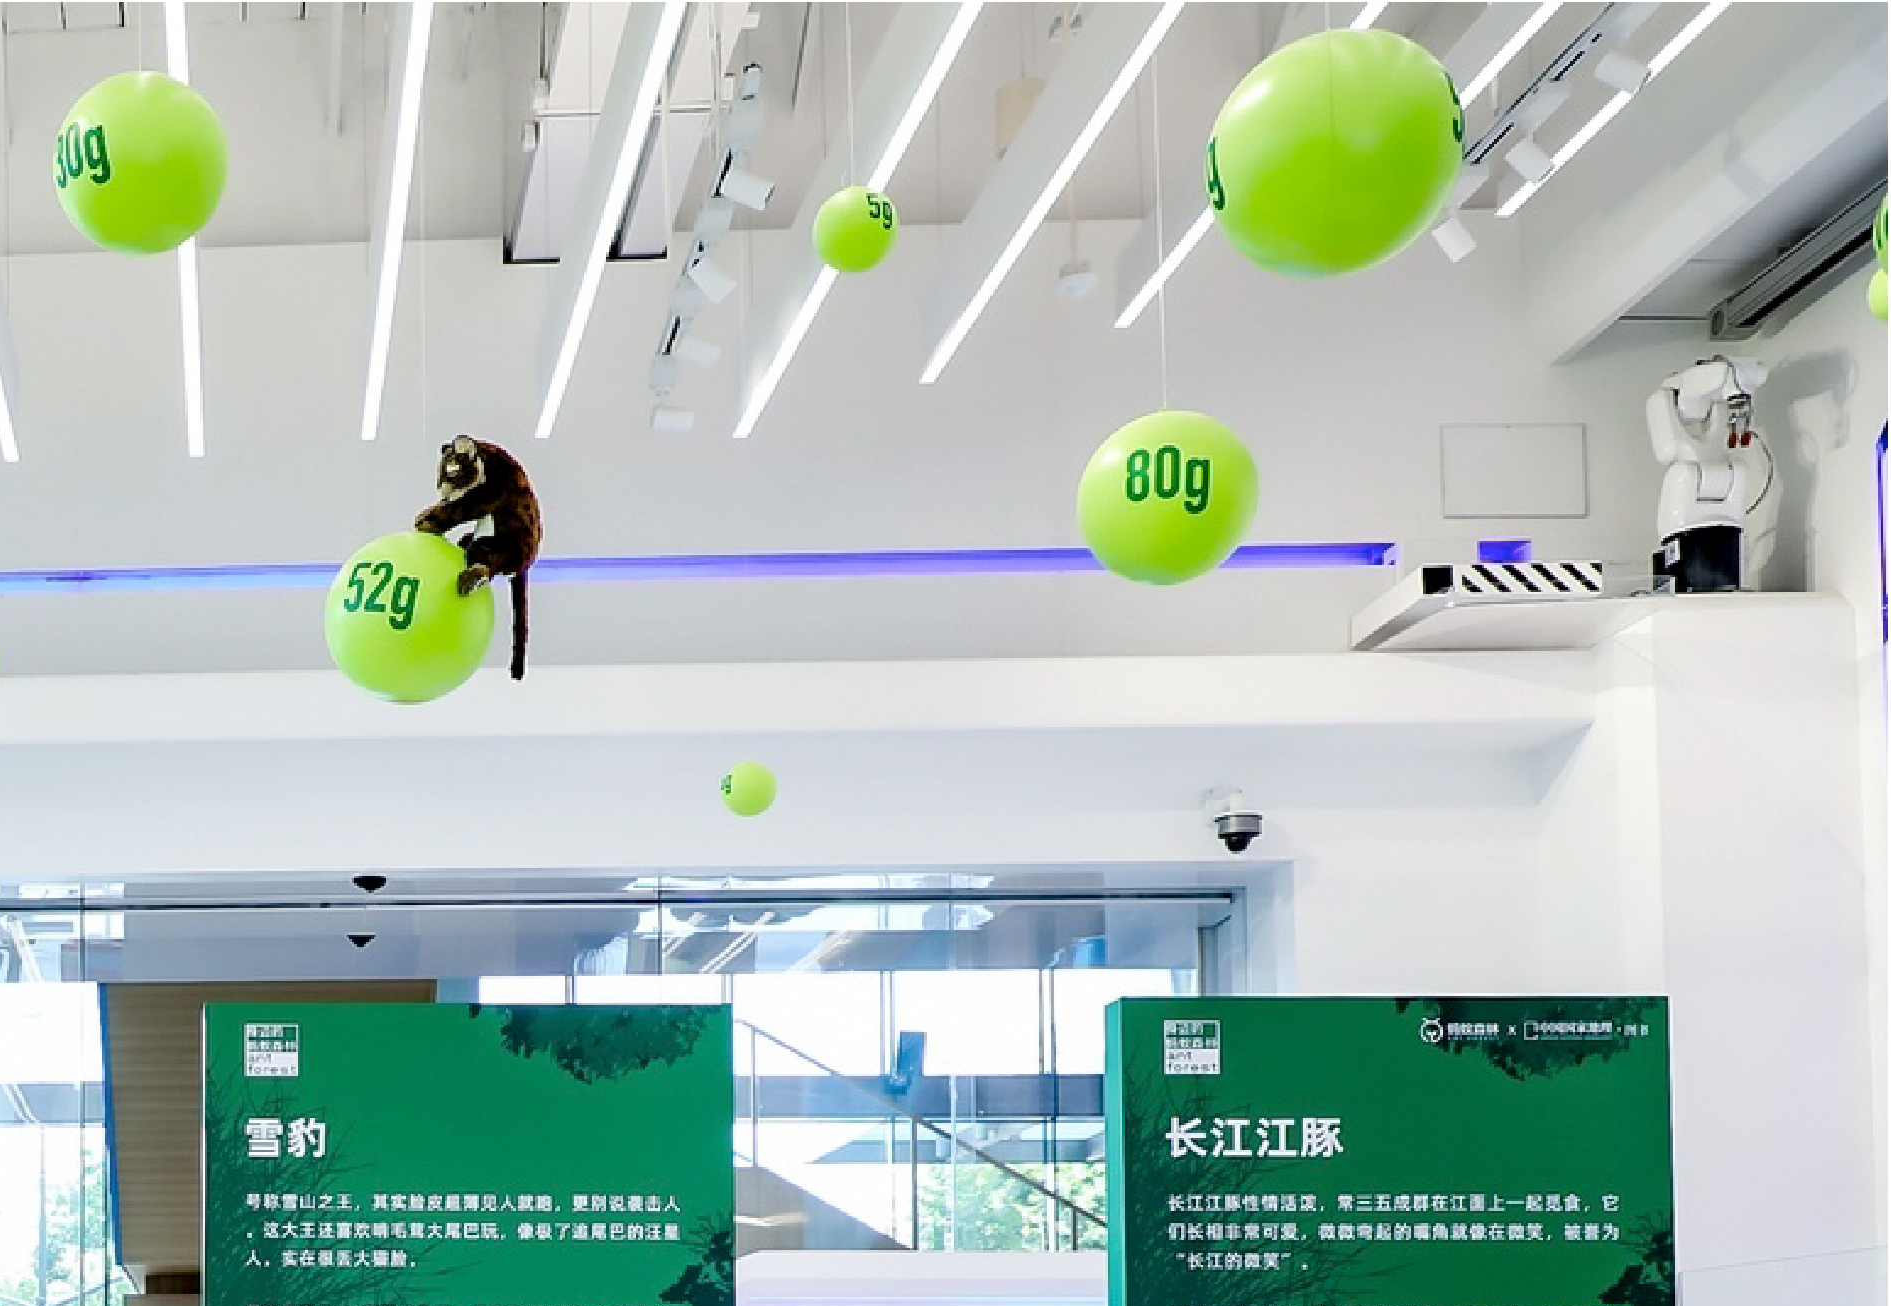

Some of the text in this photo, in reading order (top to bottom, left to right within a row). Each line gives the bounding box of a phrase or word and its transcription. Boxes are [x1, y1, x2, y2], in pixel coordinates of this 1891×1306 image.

[867, 193, 895, 229] 5g
[1126, 445, 1210, 514] 80g
[342, 561, 420, 630] 52g
[245, 1118, 326, 1157] 雪豹
[1166, 1117, 1343, 1157] 长江江豚
